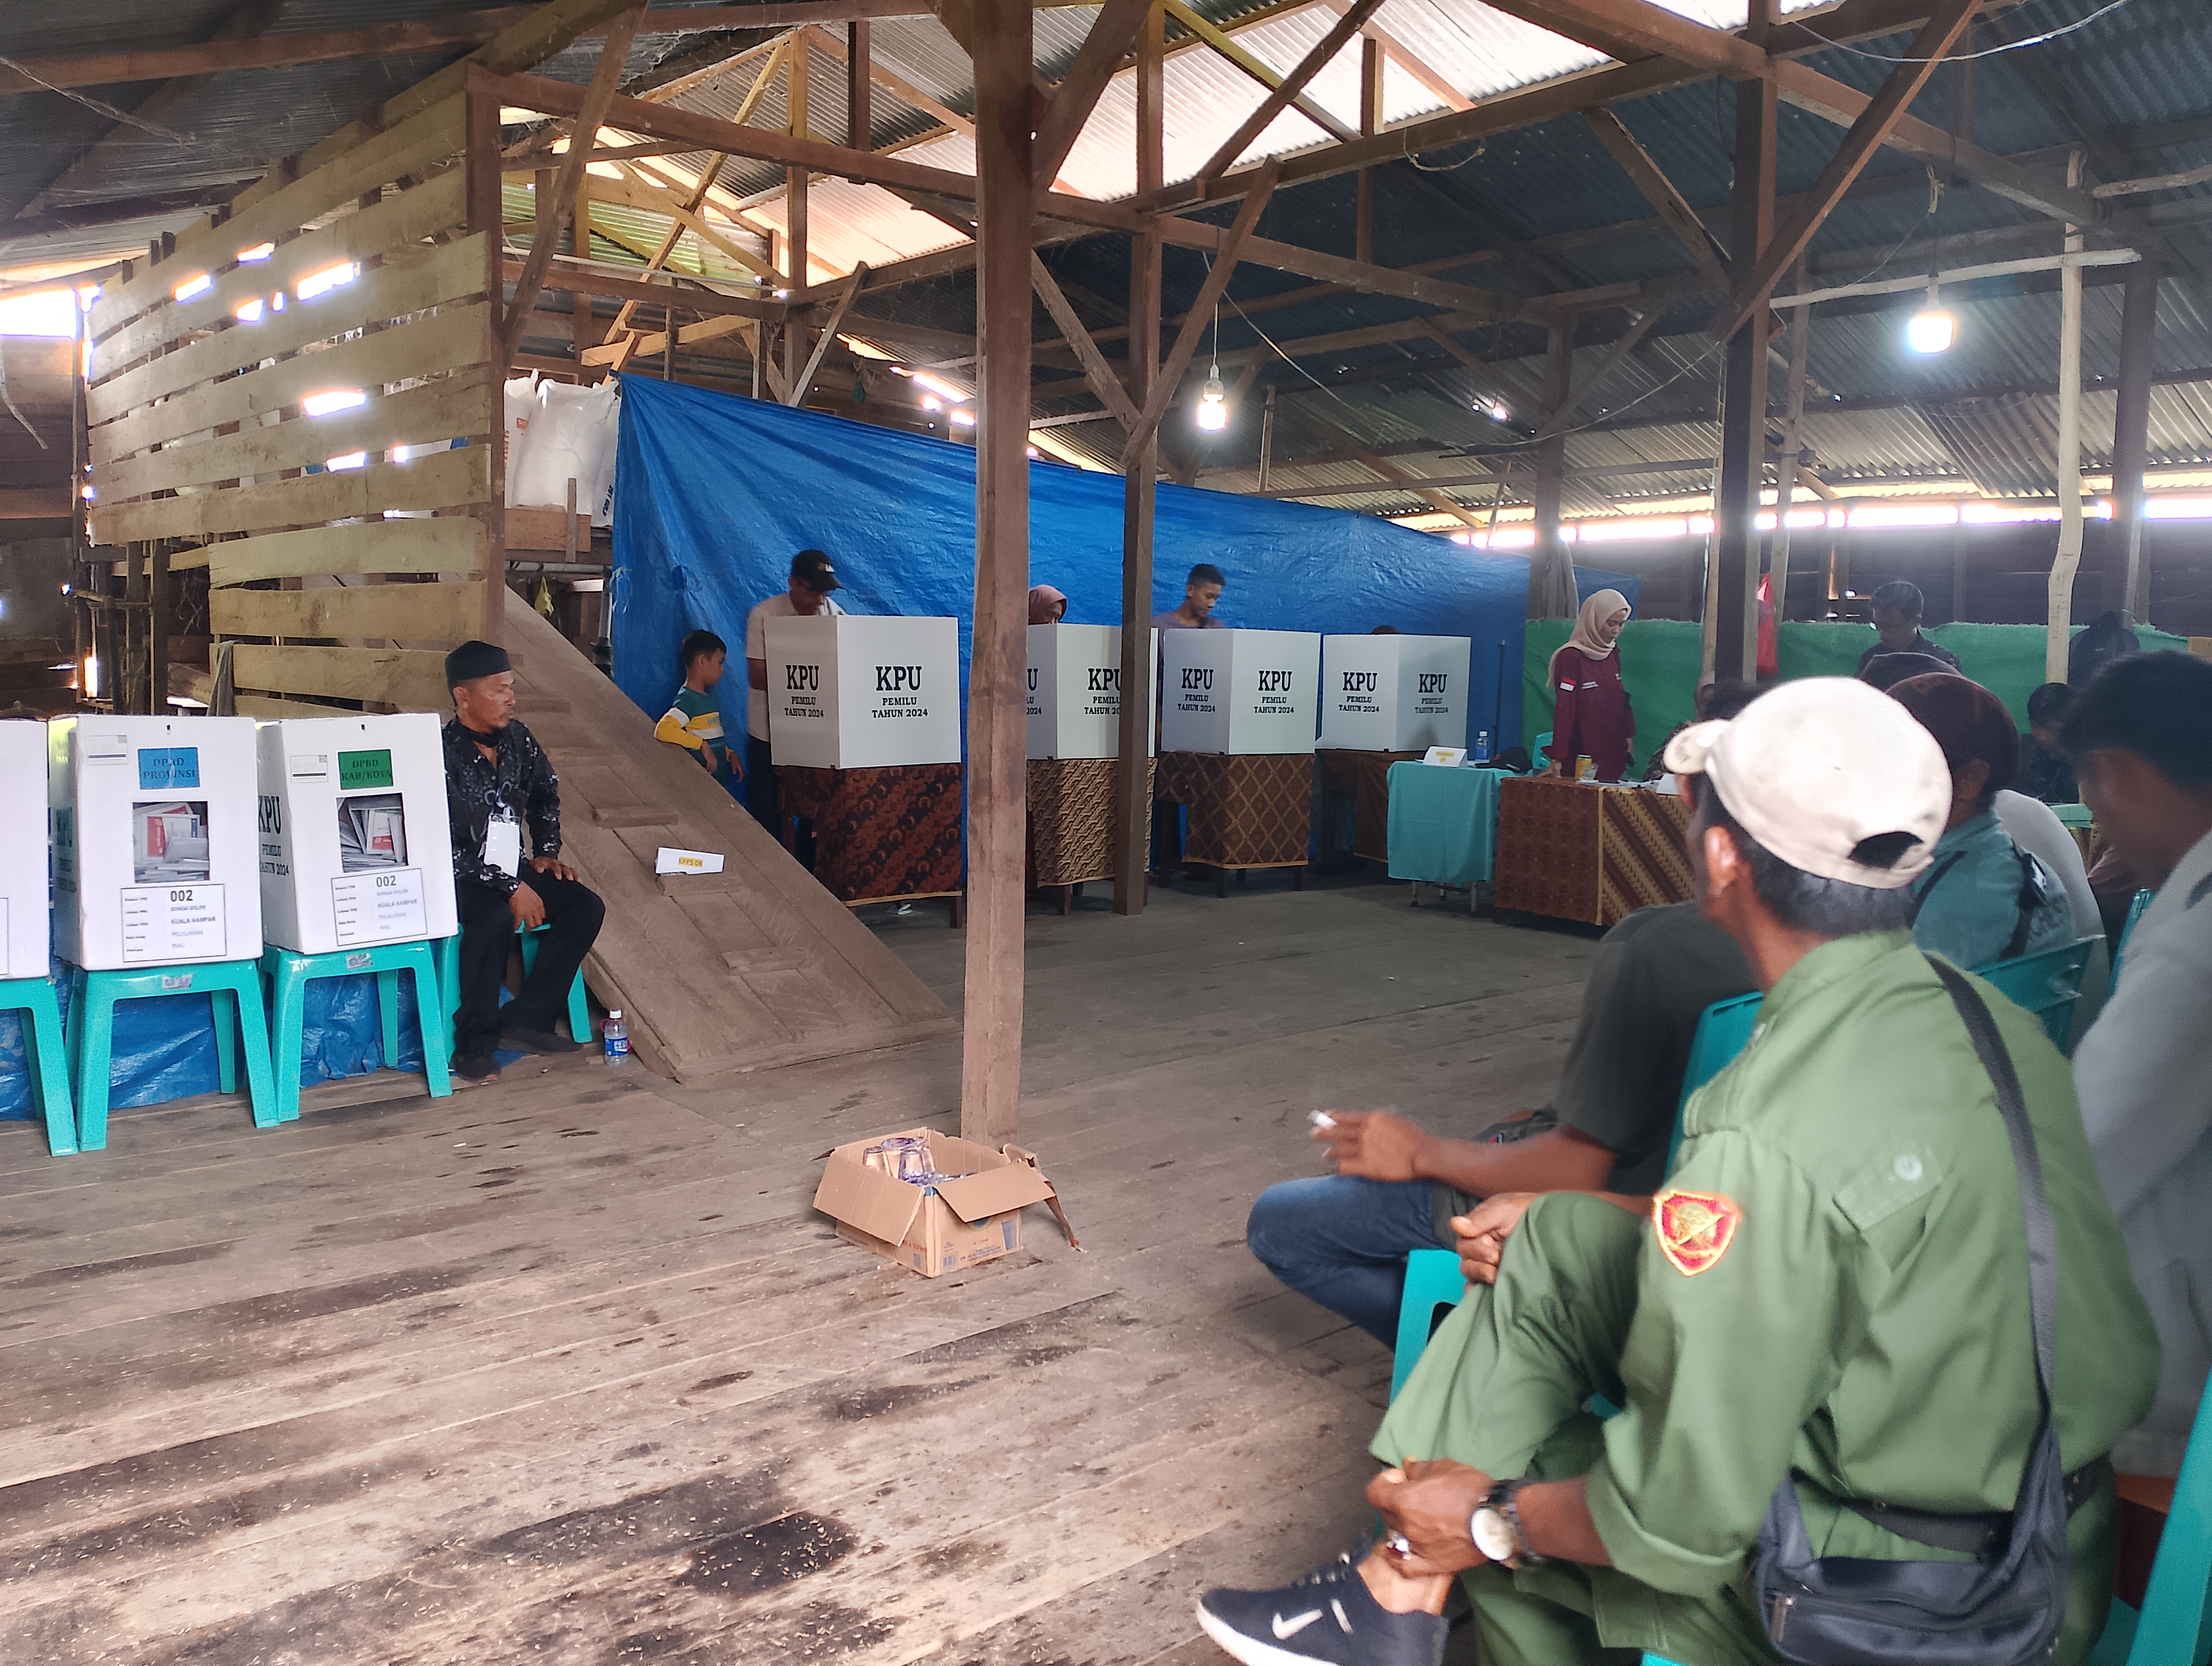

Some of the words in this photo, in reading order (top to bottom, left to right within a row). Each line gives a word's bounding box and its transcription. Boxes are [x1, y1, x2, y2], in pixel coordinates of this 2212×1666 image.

[786, 664, 819, 690] KPU
[875, 665, 922, 691] KPU
[1181, 668, 1214, 690] KPU
[1258, 670, 1293, 691] KPU
[1342, 672, 1378, 692] KPU
[1418, 674, 1448, 693] KPU
[791, 696, 816, 705] PEMILU
[882, 697, 917, 706] PEMILU
[785, 708, 807, 716] TAHUN
[808, 708, 824, 718] 2024
[872, 709, 904, 718] TAHUN
[905, 708, 928, 717] 2024
[1178, 703, 1199, 712] TAHUN
[352, 759, 379, 768] DPRD
[276, 863, 290, 876] 2024
[376, 875, 396, 887] 002
[170, 889, 193, 902] 002
